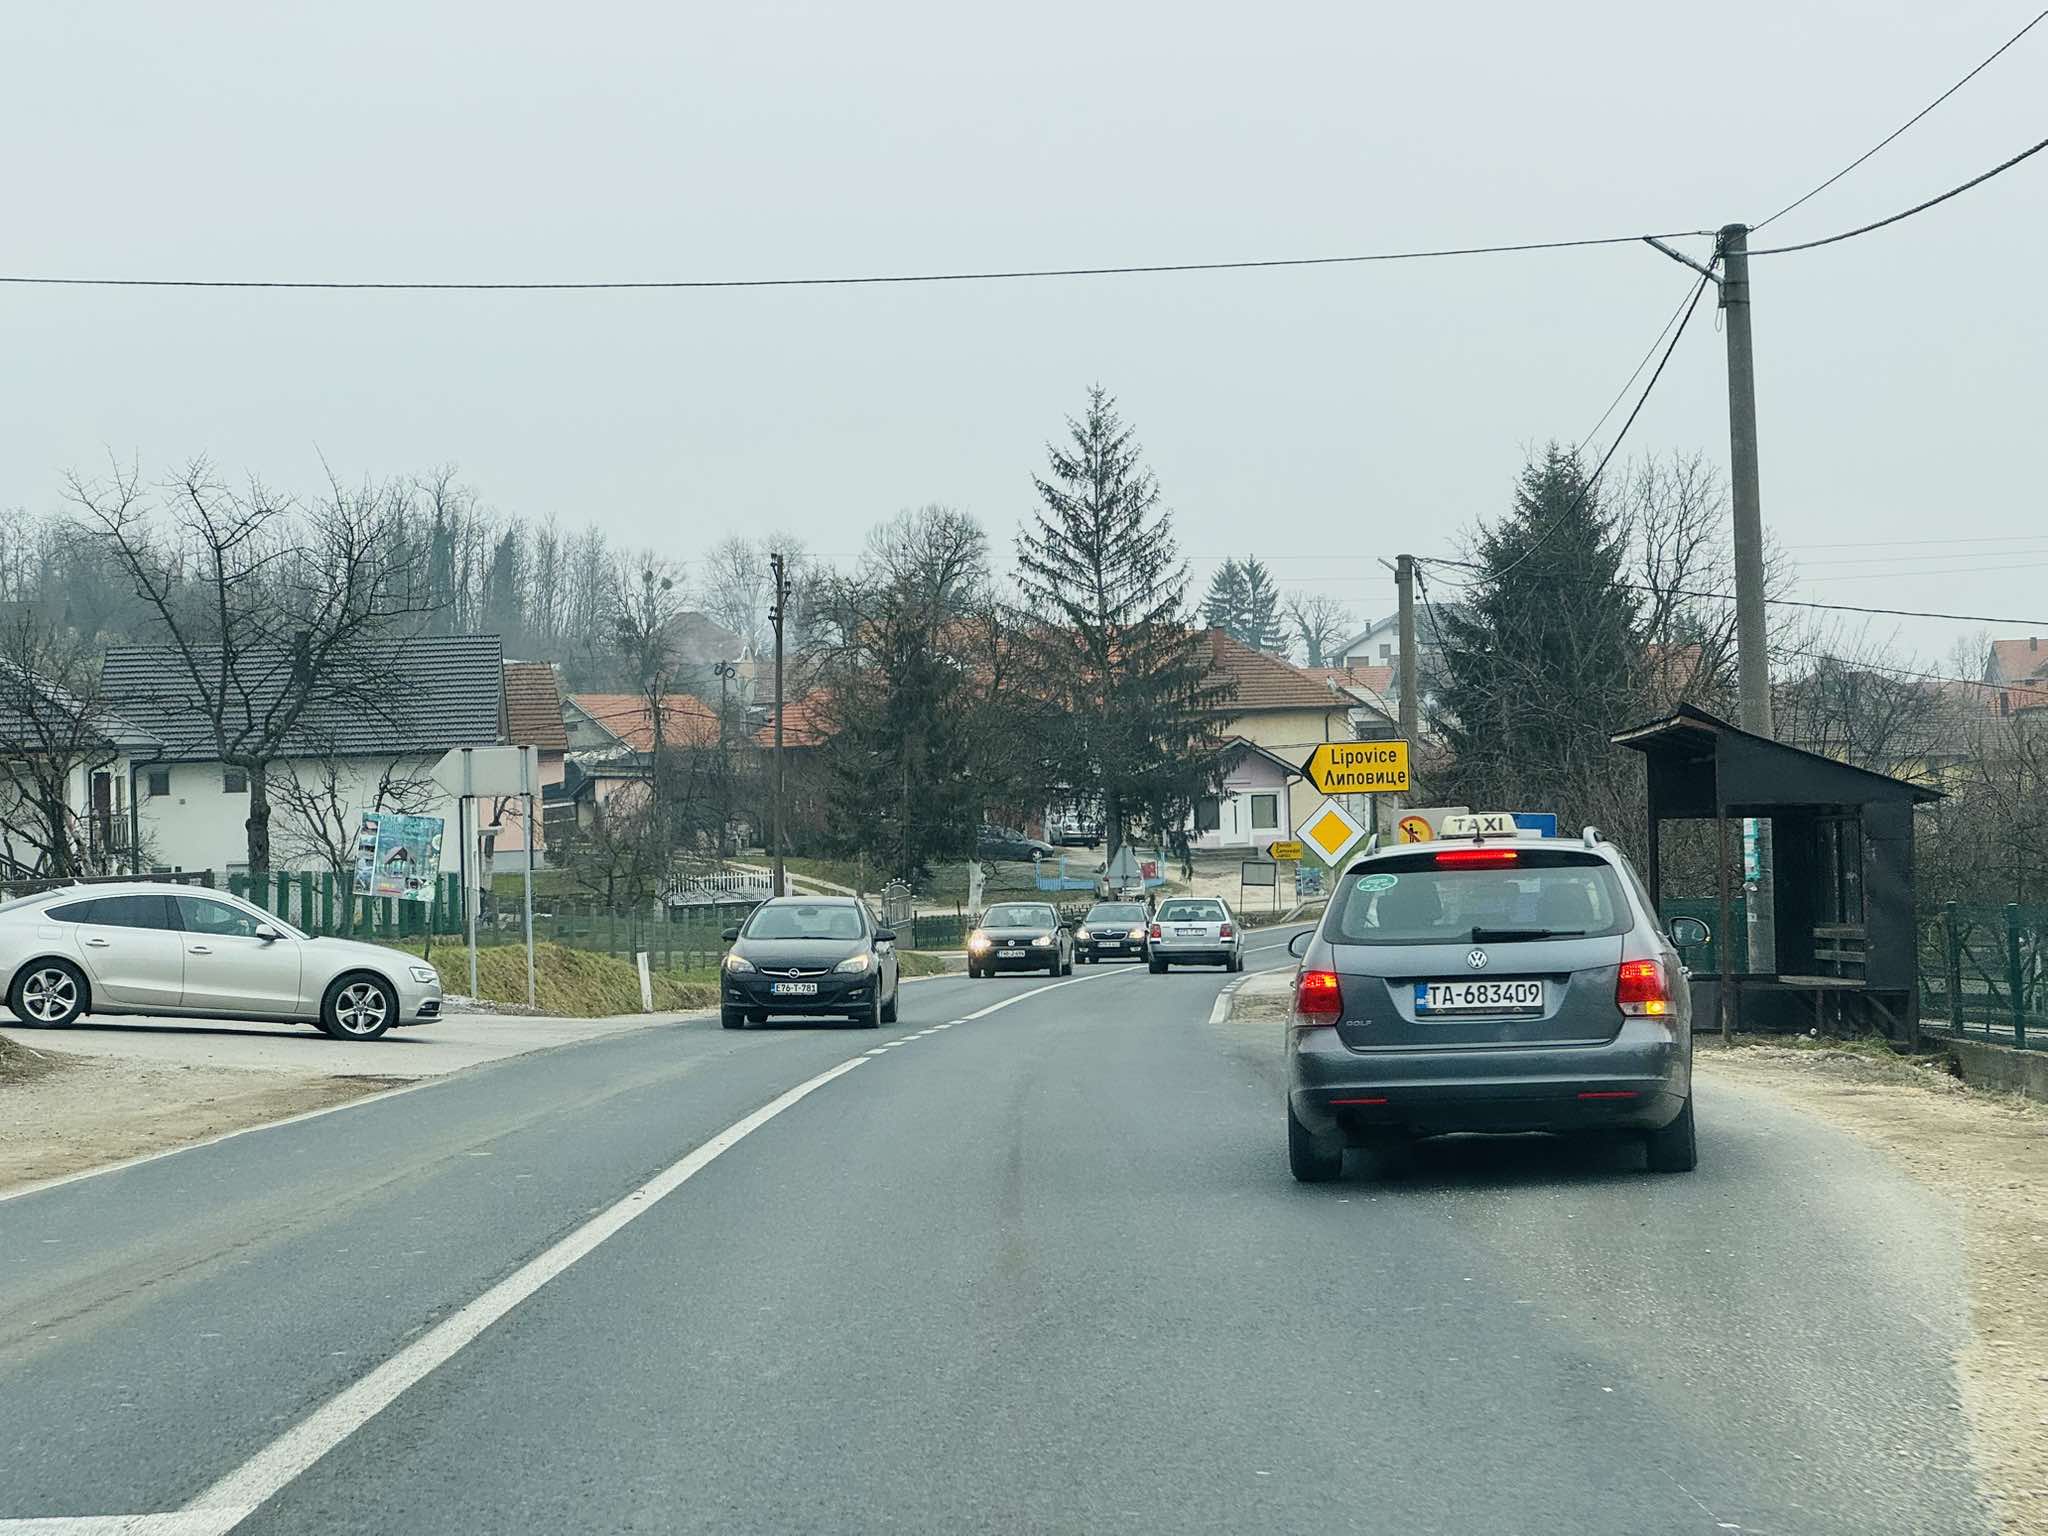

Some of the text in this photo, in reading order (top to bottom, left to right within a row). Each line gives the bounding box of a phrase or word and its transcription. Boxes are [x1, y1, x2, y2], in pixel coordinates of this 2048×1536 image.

[1331, 748, 1397, 768] Lipovice
[1324, 769, 1406, 786] Липовице
[1453, 817, 1504, 832] TAXI
[776, 983, 816, 992] E76-T-781
[1428, 983, 1540, 1006] TA-683409
[1346, 1019, 1373, 1027] GOLF
